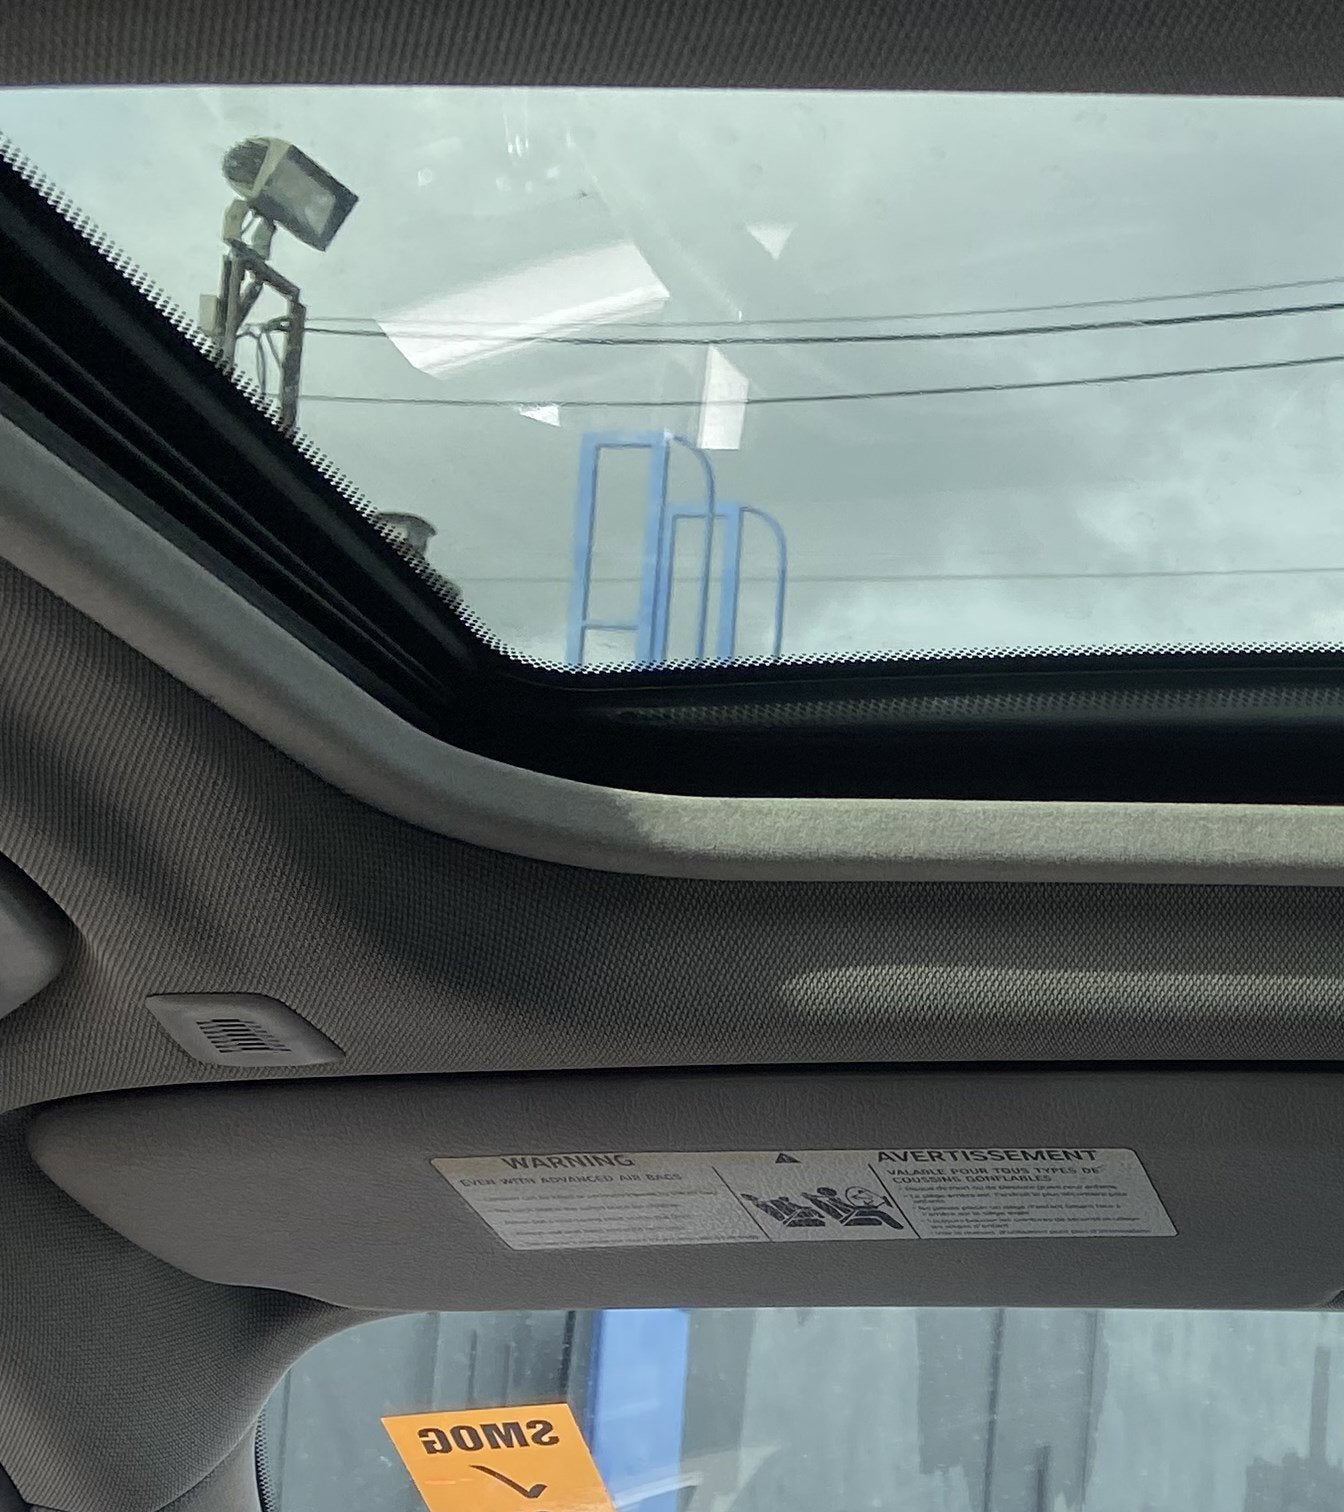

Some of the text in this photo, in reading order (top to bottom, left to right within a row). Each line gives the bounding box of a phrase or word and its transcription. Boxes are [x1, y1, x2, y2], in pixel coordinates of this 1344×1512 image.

[501, 1154, 635, 1170] WARNING
[877, 1149, 1098, 1163] AVERTISSEMENT
[950, 1168, 990, 1176] POUR
[460, 1173, 682, 1187] EVEN WITH ADVANCED AIR BAGS
